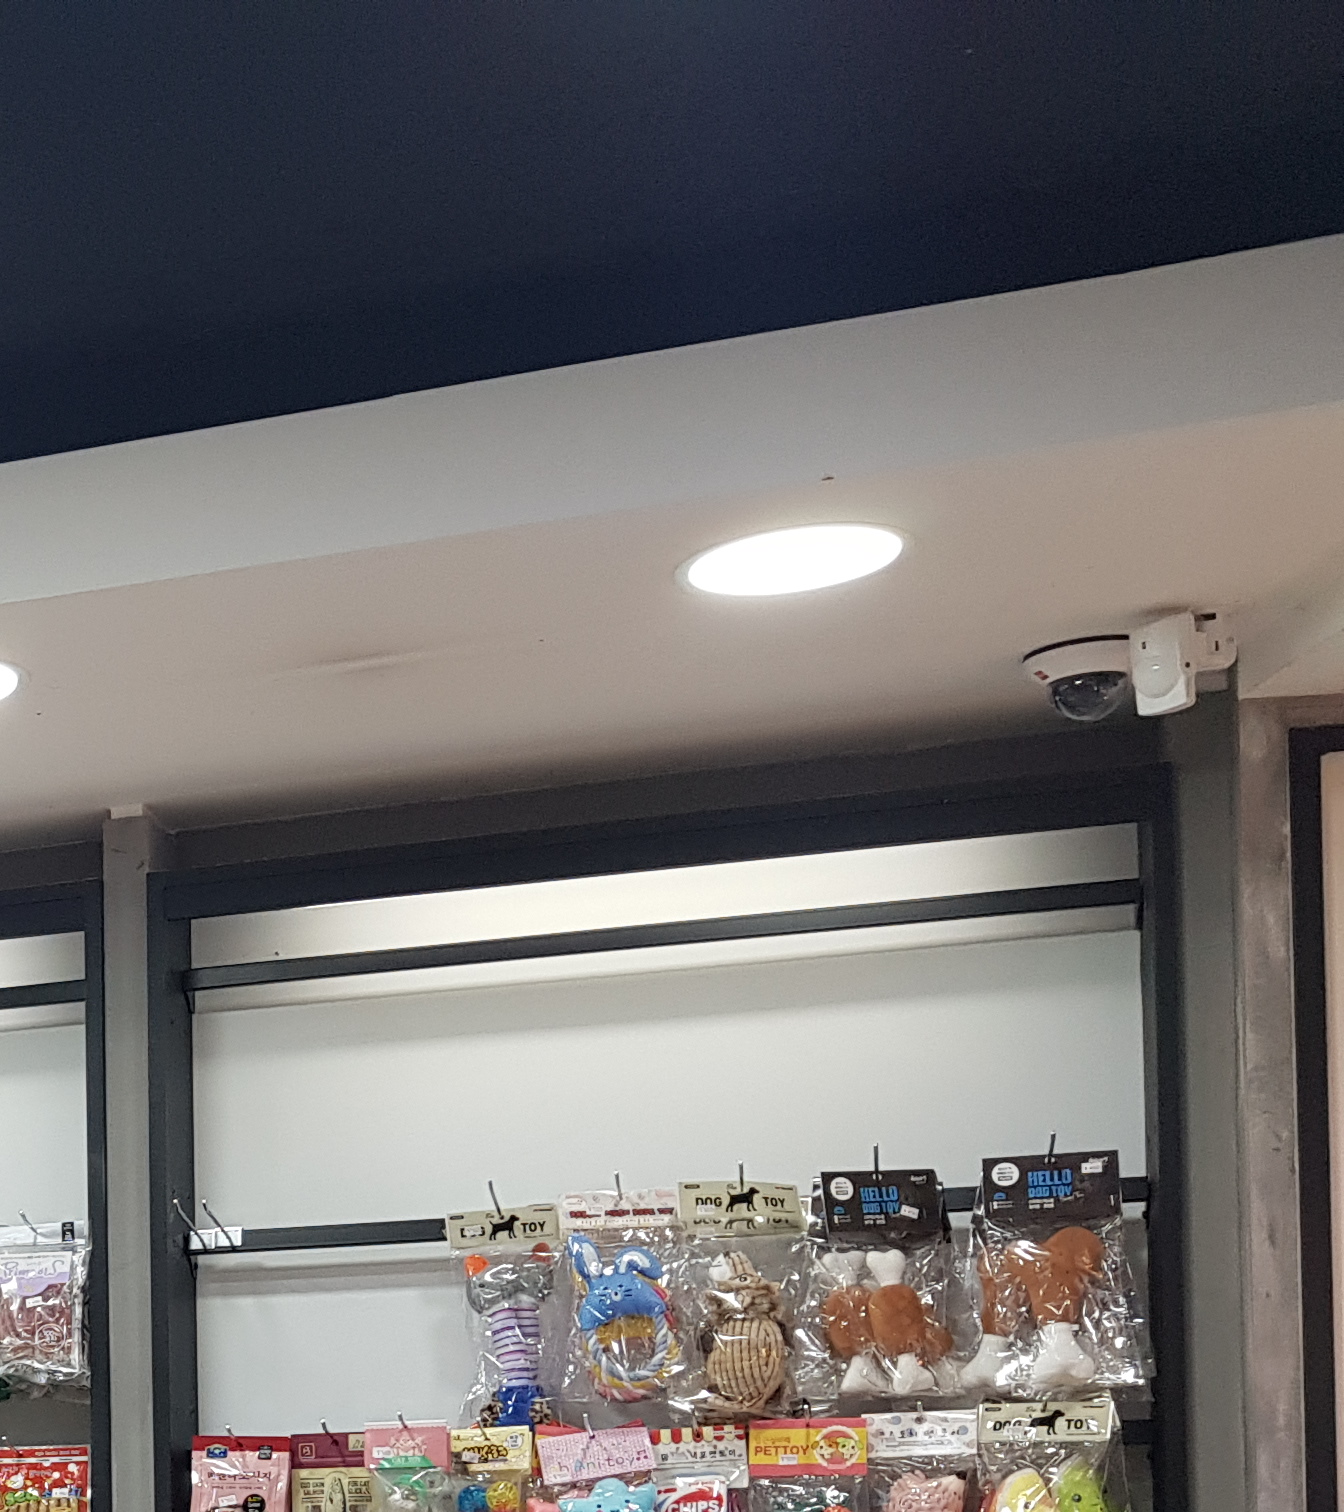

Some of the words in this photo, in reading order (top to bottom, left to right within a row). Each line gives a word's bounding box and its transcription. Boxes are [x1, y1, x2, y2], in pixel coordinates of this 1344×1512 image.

[1027, 1169, 1073, 1187] HELLO
[860, 1186, 899, 1202] HELLO
[1051, 1185, 1073, 1198] TOY
[762, 1196, 786, 1208] TOY
[881, 1202, 900, 1214] TOY
[522, 1219, 547, 1234] TOY
[754, 1445, 810, 1457] PETTOY
